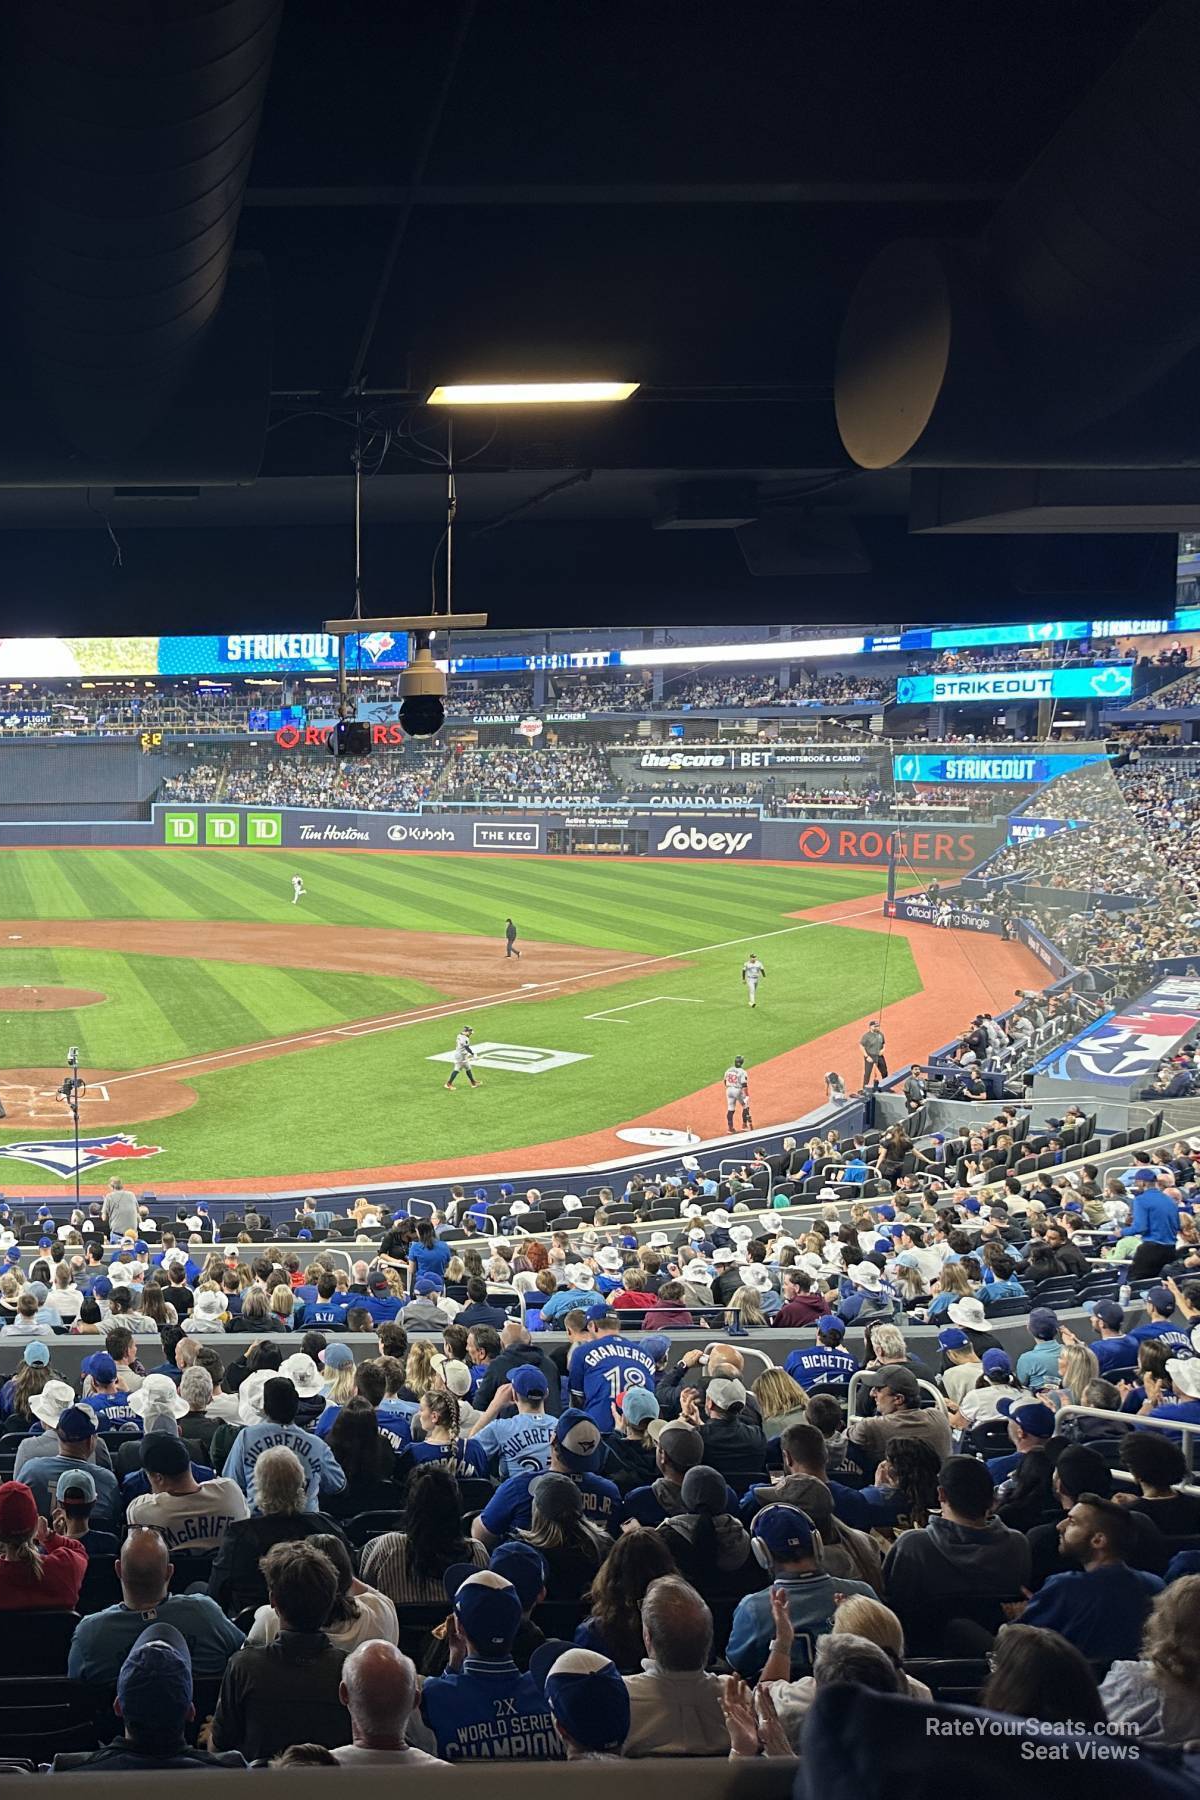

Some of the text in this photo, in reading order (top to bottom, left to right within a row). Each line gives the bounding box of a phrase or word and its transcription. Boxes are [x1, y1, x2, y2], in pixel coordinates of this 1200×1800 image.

[227, 634, 339, 661] STRIKEOUT
[935, 678, 1051, 695] STRIKEOUT
[23, 715, 51, 723] FLIGHT
[305, 724, 404, 745] RORS
[640, 751, 725, 767] theScore
[740, 751, 772, 767] BET
[832, 755, 861, 763] CASINO
[946, 759, 1036, 780] STRIKEOUT
[650, 796, 715, 809] CANADA
[169, 819, 195, 839] TD
[209, 819, 236, 840] TD
[251, 819, 278, 840] TD
[299, 825, 370, 841] Tim Hortons
[408, 827, 455, 841] Kubota
[481, 830, 532, 842] THE KEG
[657, 824, 753, 855] Sobeys
[839, 829, 977, 862] ROGERS
[906, 905, 931, 919] Official
[961, 913, 990, 929] Shingle
[315, 1312, 334, 1322] RYU
[584, 1344, 657, 1375] GRANDERSON
[801, 1354, 855, 1372] BICHETTE
[493, 1697, 519, 1717] 2X
[456, 1713, 554, 1744] WORLD SERIE
[445, 1730, 566, 1759] CHAMPION
